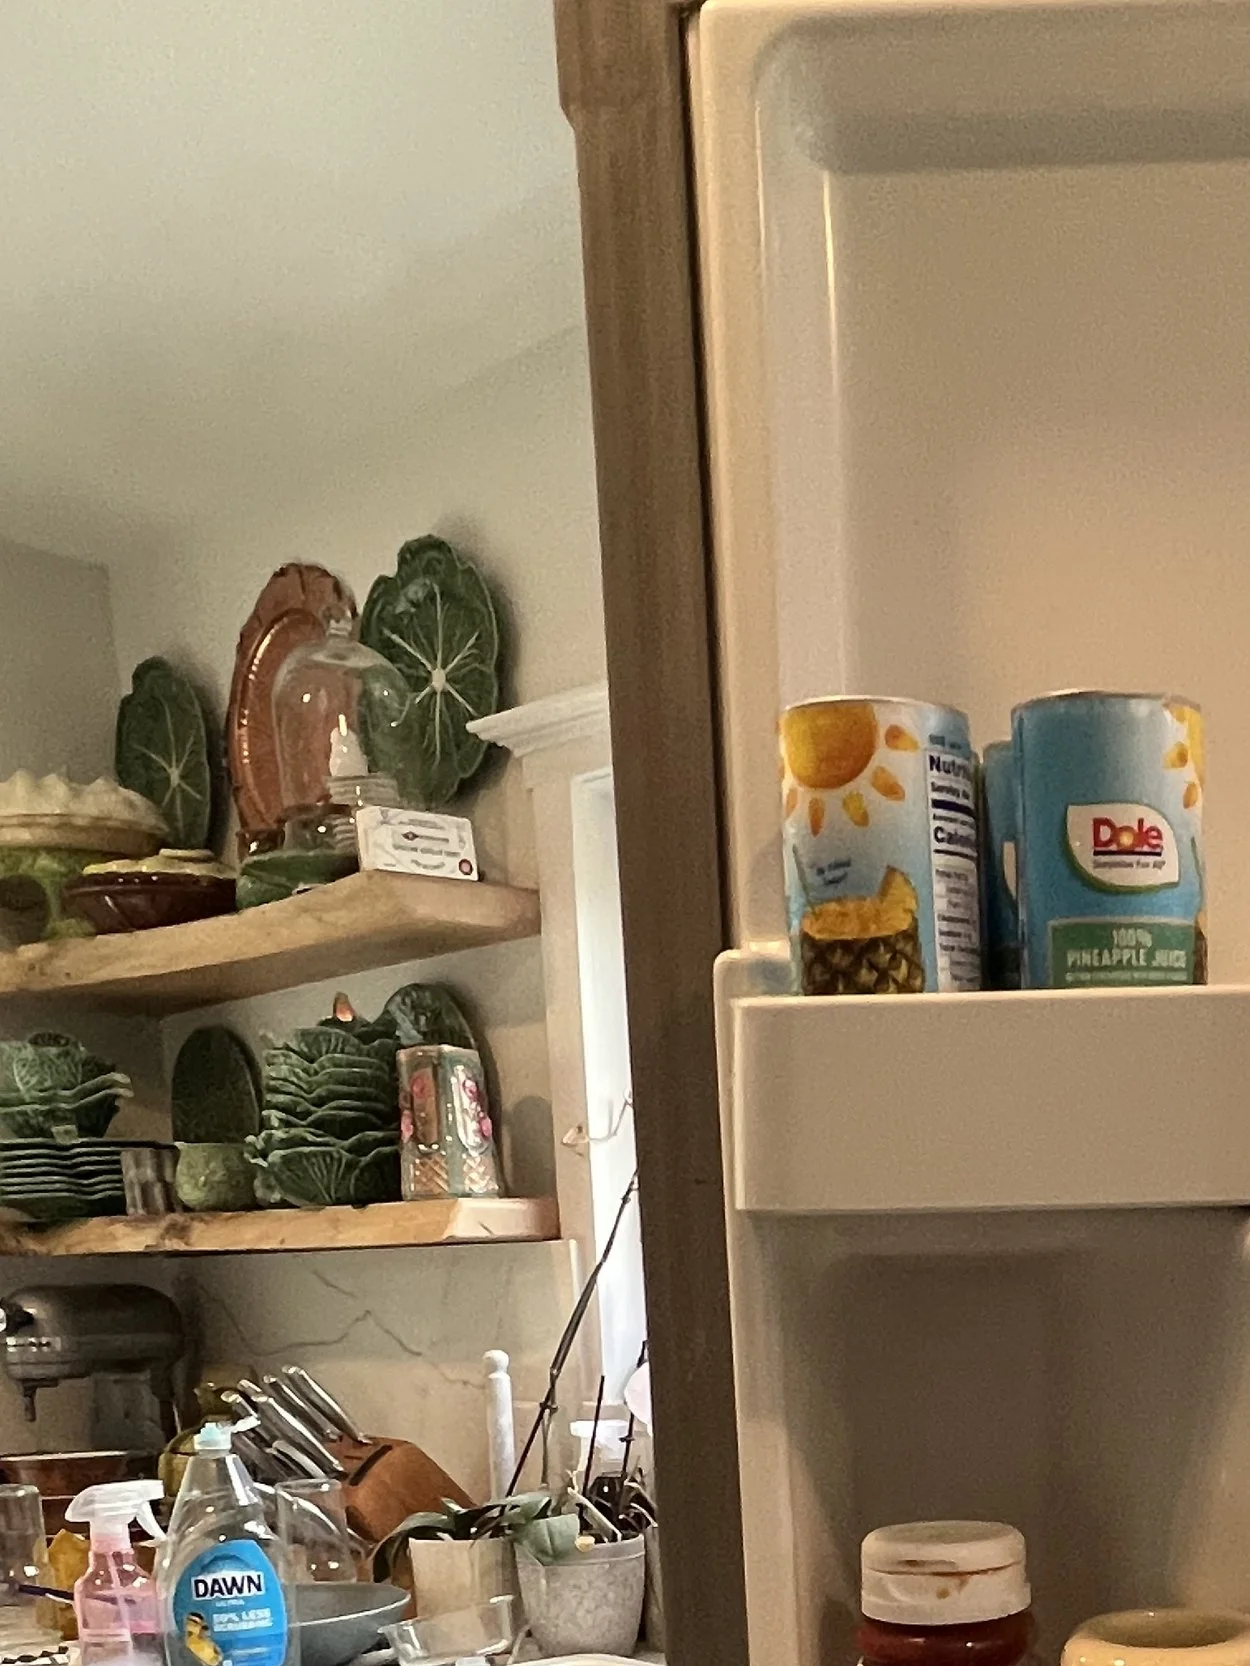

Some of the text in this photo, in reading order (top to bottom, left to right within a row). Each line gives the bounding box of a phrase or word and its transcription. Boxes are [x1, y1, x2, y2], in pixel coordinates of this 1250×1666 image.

[1092, 817, 1164, 850] Dole
[1066, 948, 1187, 969] PINEAPPLE JUICE
[193, 1574, 262, 1598] DAWN
